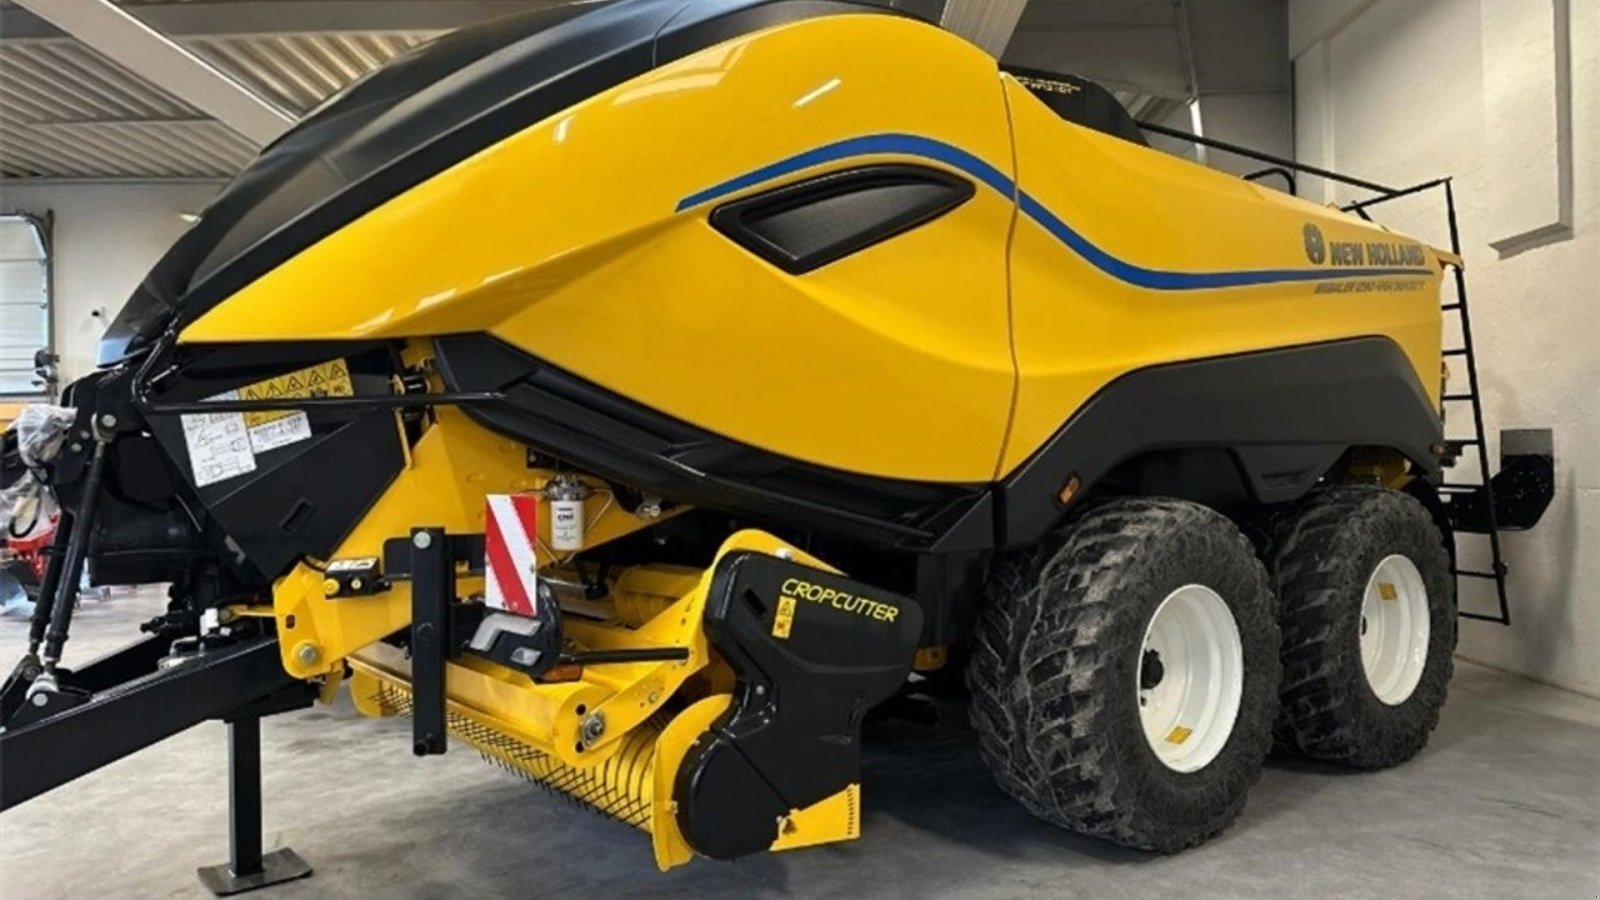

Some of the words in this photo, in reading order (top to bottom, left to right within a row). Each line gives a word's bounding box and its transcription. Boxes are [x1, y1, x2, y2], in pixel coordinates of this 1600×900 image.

[1329, 241, 1363, 266] NEW
[1365, 242, 1425, 266] HOLLAND
[781, 578, 899, 622] CROPCUTTER
